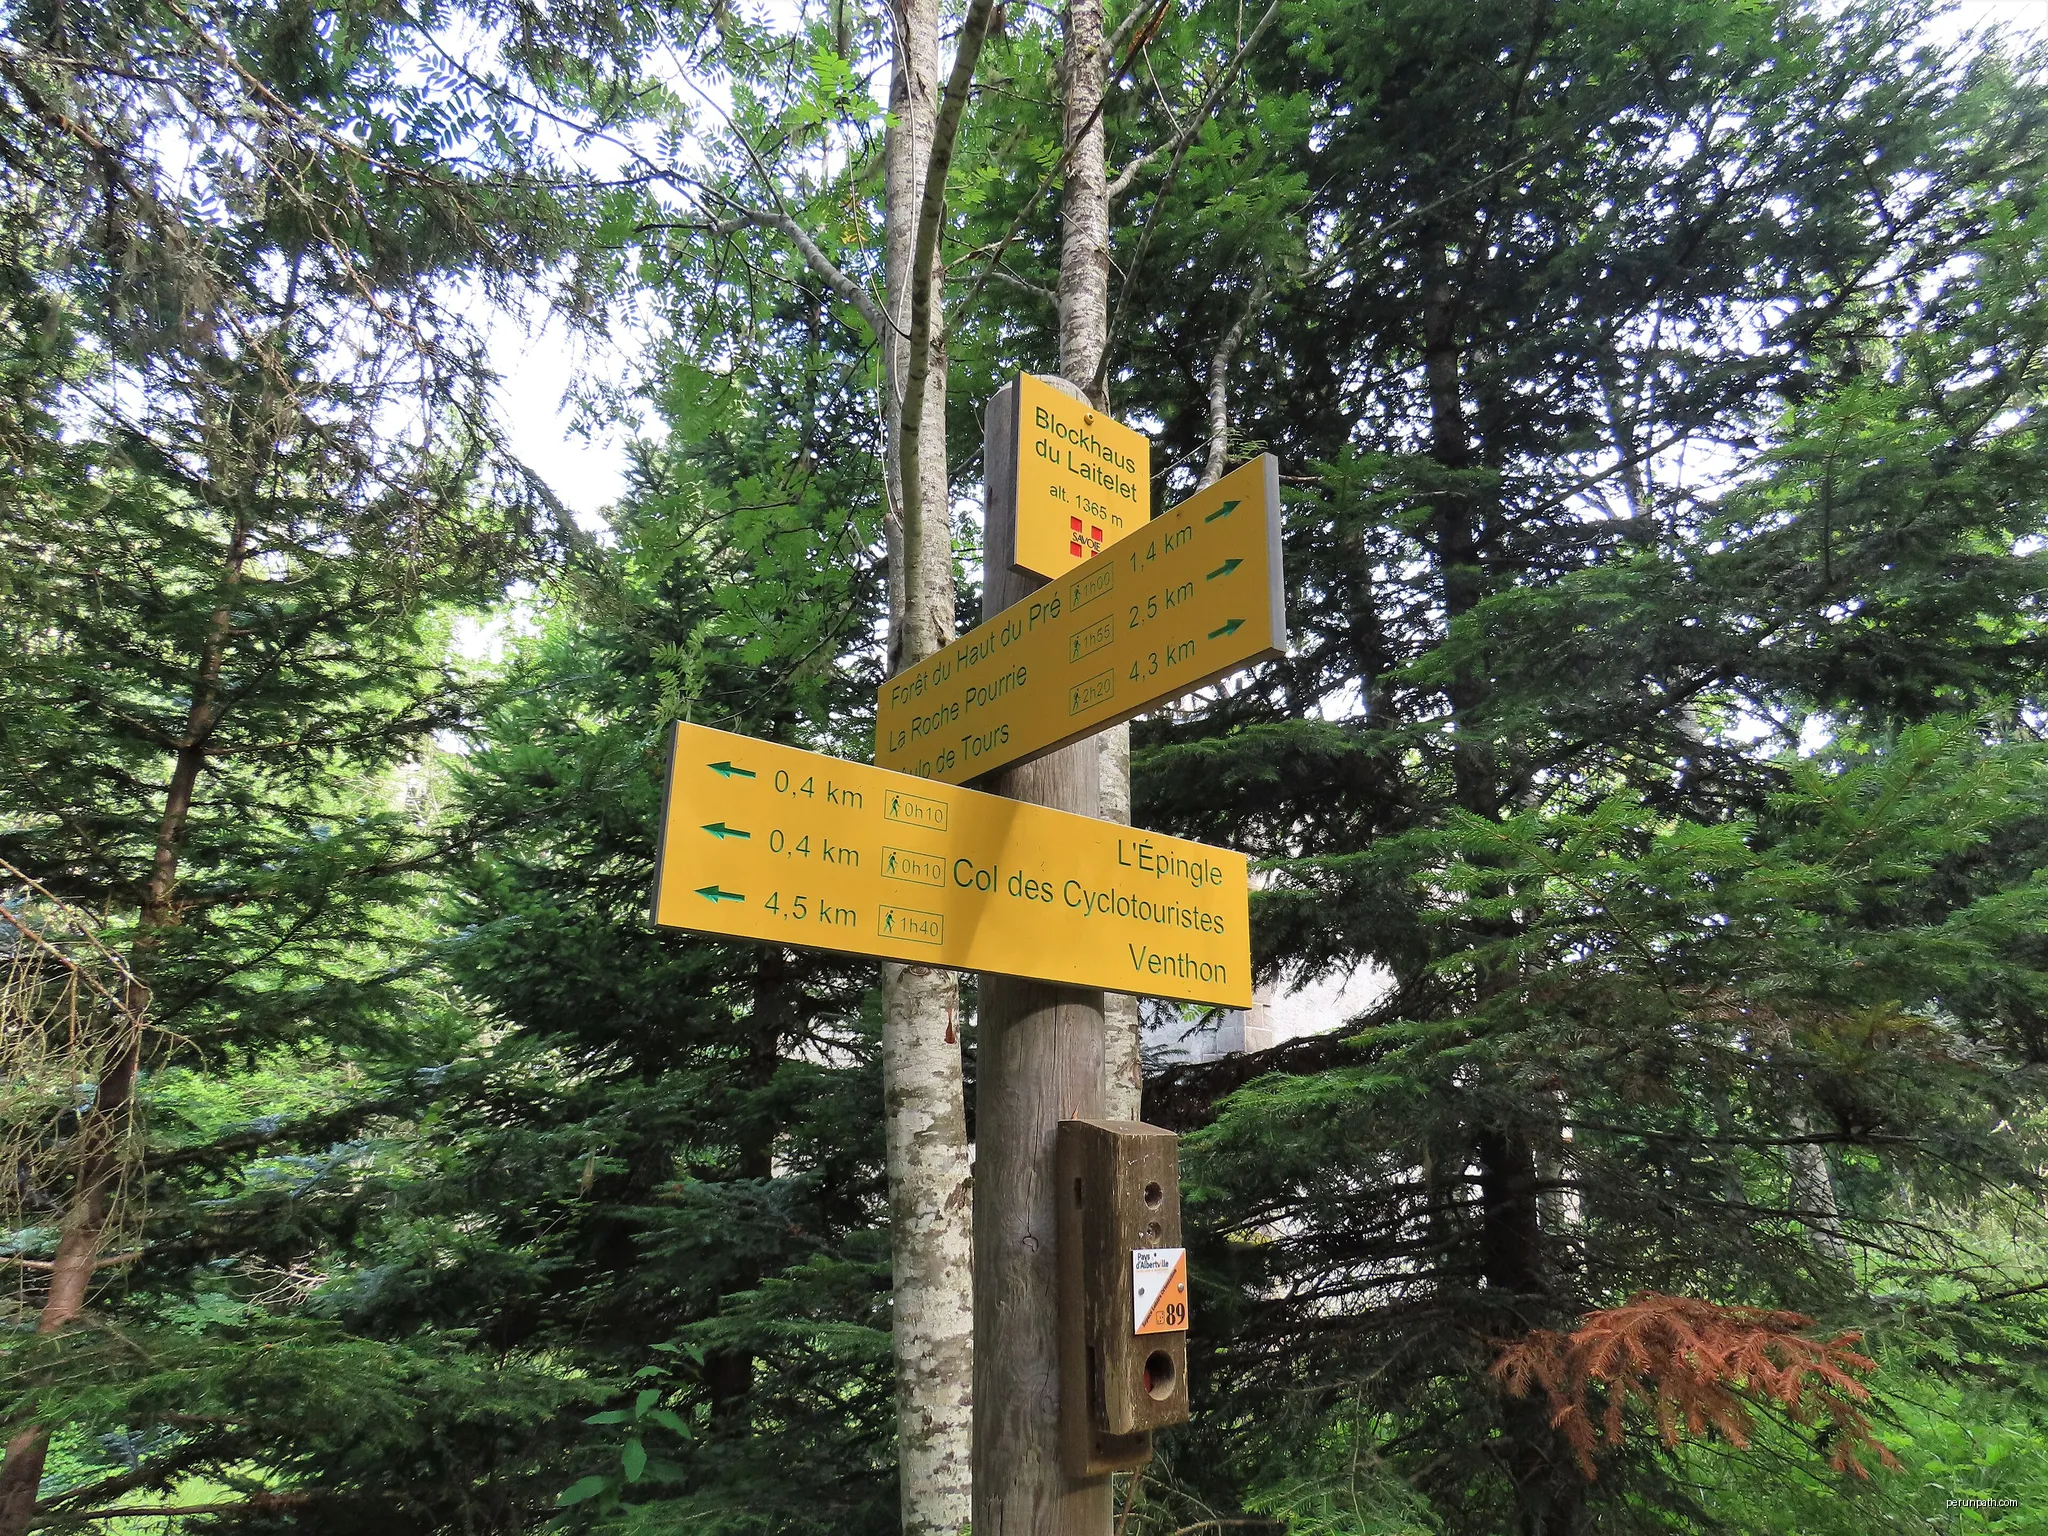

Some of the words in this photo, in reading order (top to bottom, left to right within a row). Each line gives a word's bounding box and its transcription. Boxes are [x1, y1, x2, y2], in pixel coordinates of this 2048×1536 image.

[1035, 405, 1136, 474] Blockhaus
[1035, 438, 1060, 465] du
[1067, 450, 1138, 503] Laitelet
[1049, 484, 1070, 504] alt.
[1075, 494, 1108, 520] 1365
[1111, 514, 1124, 529] m
[1072, 532, 1101, 552] SAVOIE
[891, 671, 928, 710] Forêt
[932, 661, 951, 686] du
[956, 632, 996, 673] Haut
[1000, 620, 1022, 647] du
[1029, 592, 1062, 631] Pré
[1083, 571, 1111, 596] 1h00
[1129, 541, 1157, 573] 1,4
[1164, 524, 1193, 554] km
[889, 730, 906, 753] La
[911, 702, 959, 742] Roche
[965, 665, 1027, 713] Pourrie
[1083, 623, 1111, 648] 1h55
[1128, 595, 1158, 629] 2,5
[1165, 581, 1194, 610] km
[936, 748, 955, 773] de
[961, 724, 1010, 760] Tours
[1082, 679, 1111, 705] 2h20
[1128, 652, 1159, 683] 4,3
[1166, 639, 1196, 667] km
[774, 769, 815, 799] 0,4
[827, 780, 863, 809] km
[904, 802, 943, 824] 0h10
[1117, 838, 1223, 889] L'Épingle
[769, 829, 811, 859] 0,4
[823, 839, 860, 867] km
[901, 858, 941, 881] 0h10
[953, 858, 998, 893] Col
[1007, 870, 1054, 903] des
[1063, 879, 1225, 935] Cyclotouristes
[764, 891, 808, 921] 4,5
[819, 899, 857, 927] km
[899, 917, 940, 937] 1h40
[1128, 942, 1228, 984] Venthon
[1135, 1259, 1169, 1270] d'Albertville
[1137, 1252, 1151, 1261] Pays
[1166, 1302, 1186, 1326] 89
